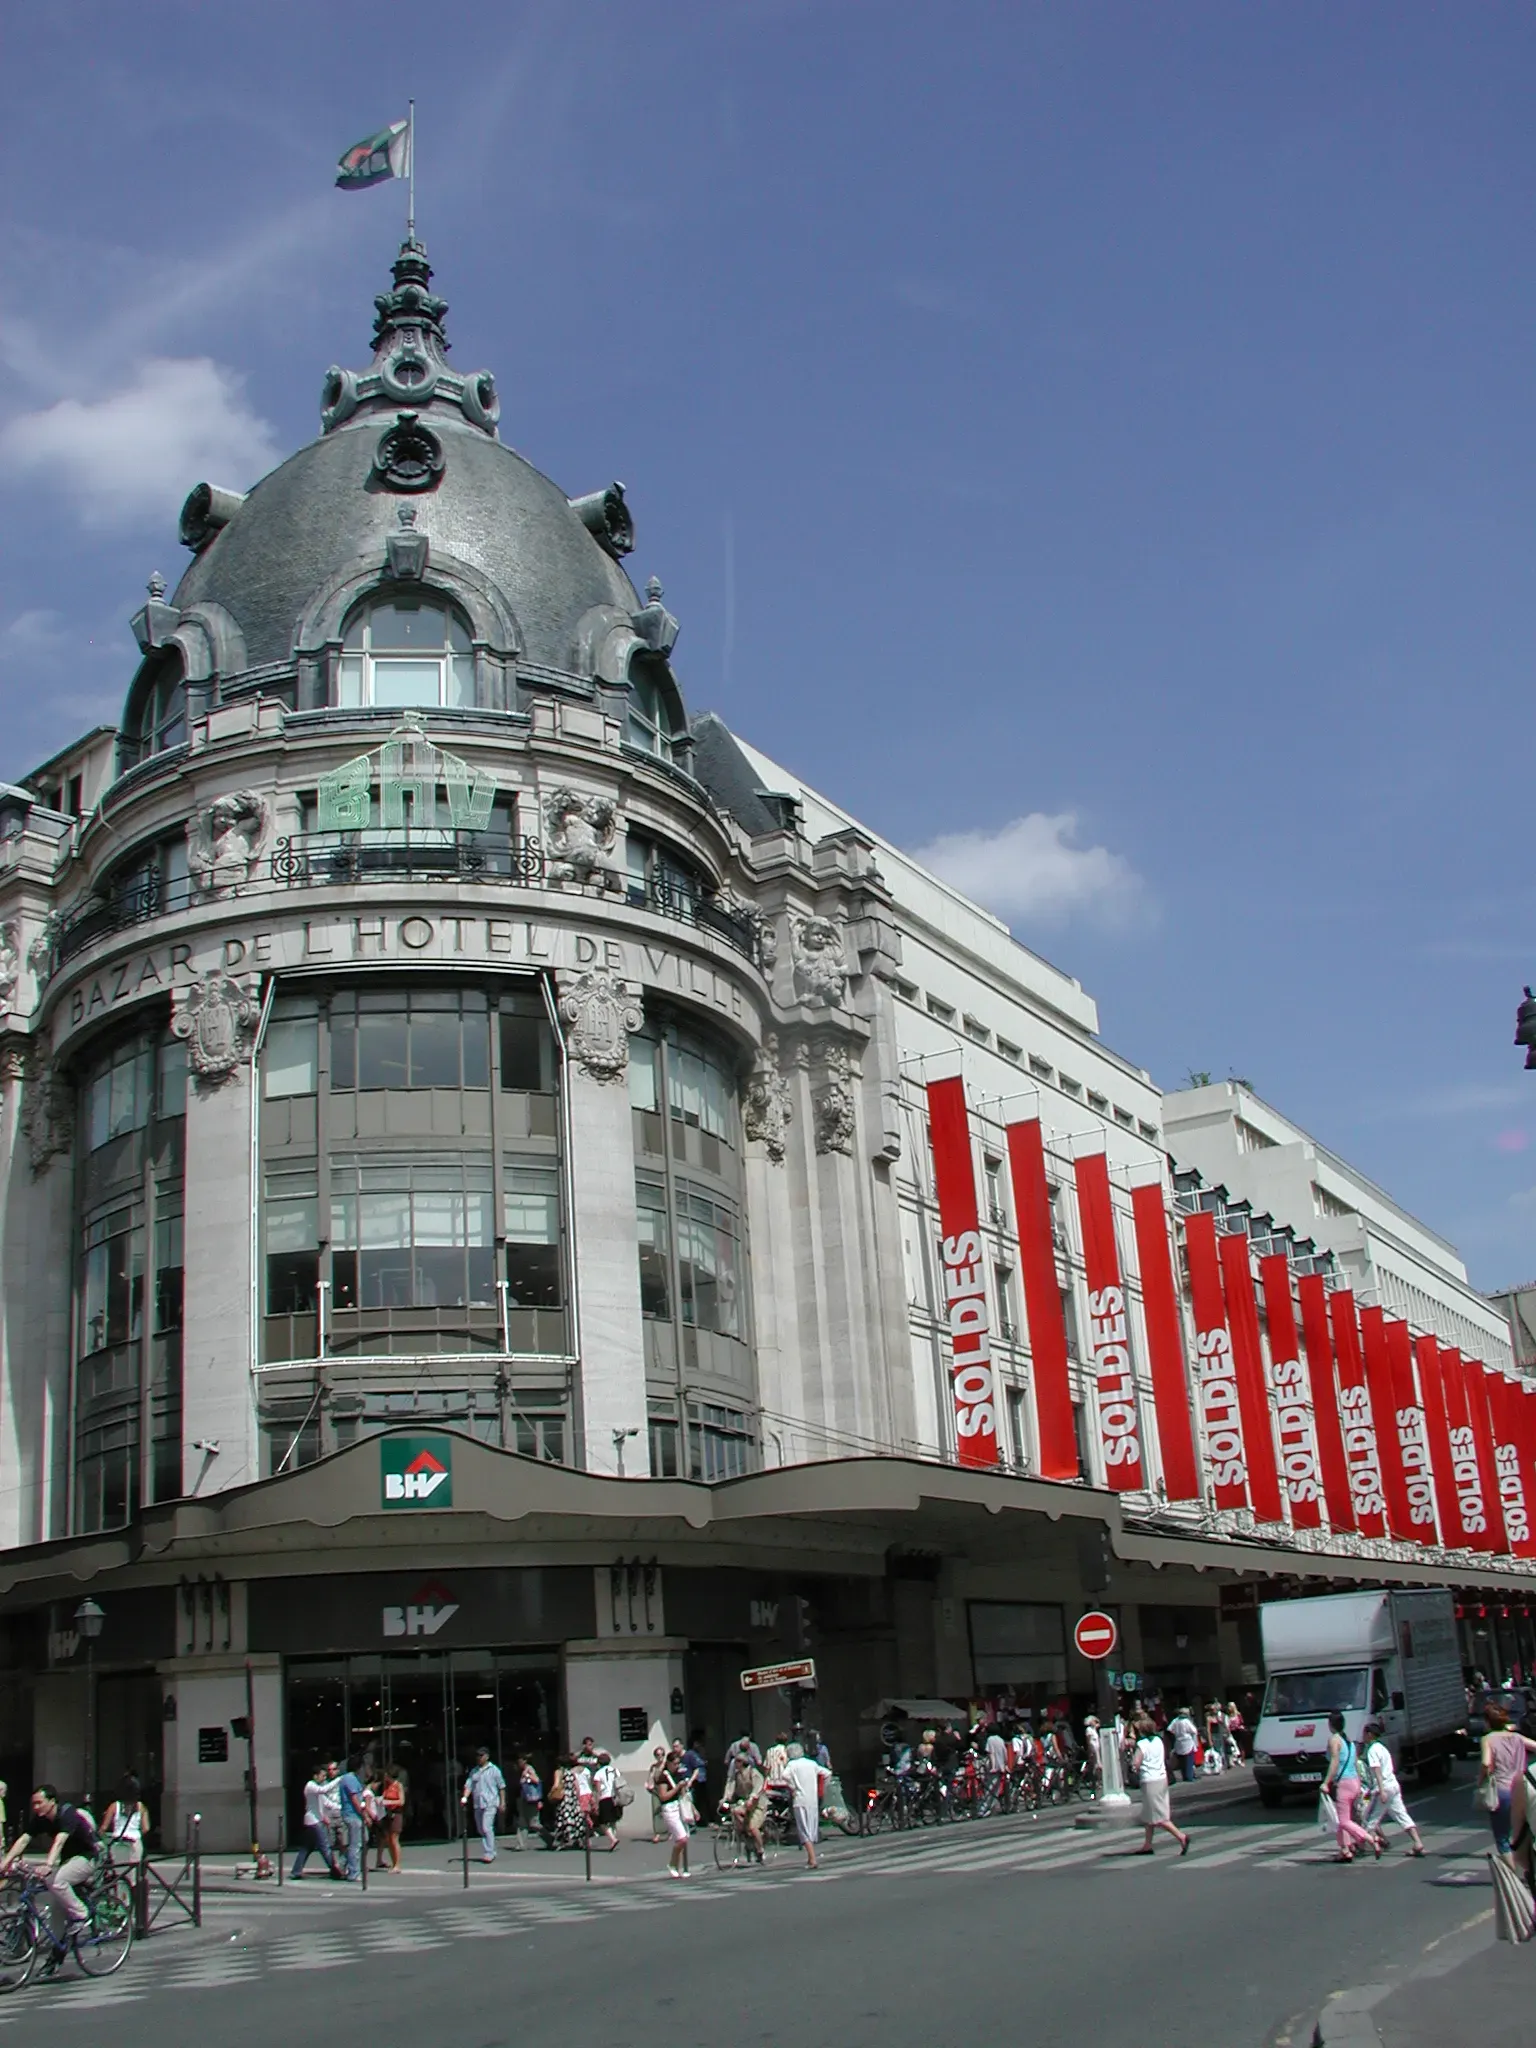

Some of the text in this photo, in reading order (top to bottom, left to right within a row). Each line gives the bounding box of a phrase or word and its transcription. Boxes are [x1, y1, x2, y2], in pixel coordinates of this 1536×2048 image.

[318, 741, 497, 831] BHV
[70, 915, 742, 1027] BAZAR DE L'HOTEL DE VILLE
[943, 1230, 995, 1438] SOLDES
[1089, 1286, 1141, 1466] SOLDES
[1197, 1327, 1244, 1487] SOLDES
[1273, 1359, 1318, 1503] SOLDES
[1341, 1385, 1383, 1515] SOLDES
[385, 1472, 449, 1499] BHV
[1396, 1406, 1434, 1525] SOLDES
[1449, 1425, 1486, 1534] SOLDES
[1495, 1443, 1529, 1542] SOLDES
[383, 1604, 460, 1636] BHV
[750, 1600, 779, 1628] BHV
